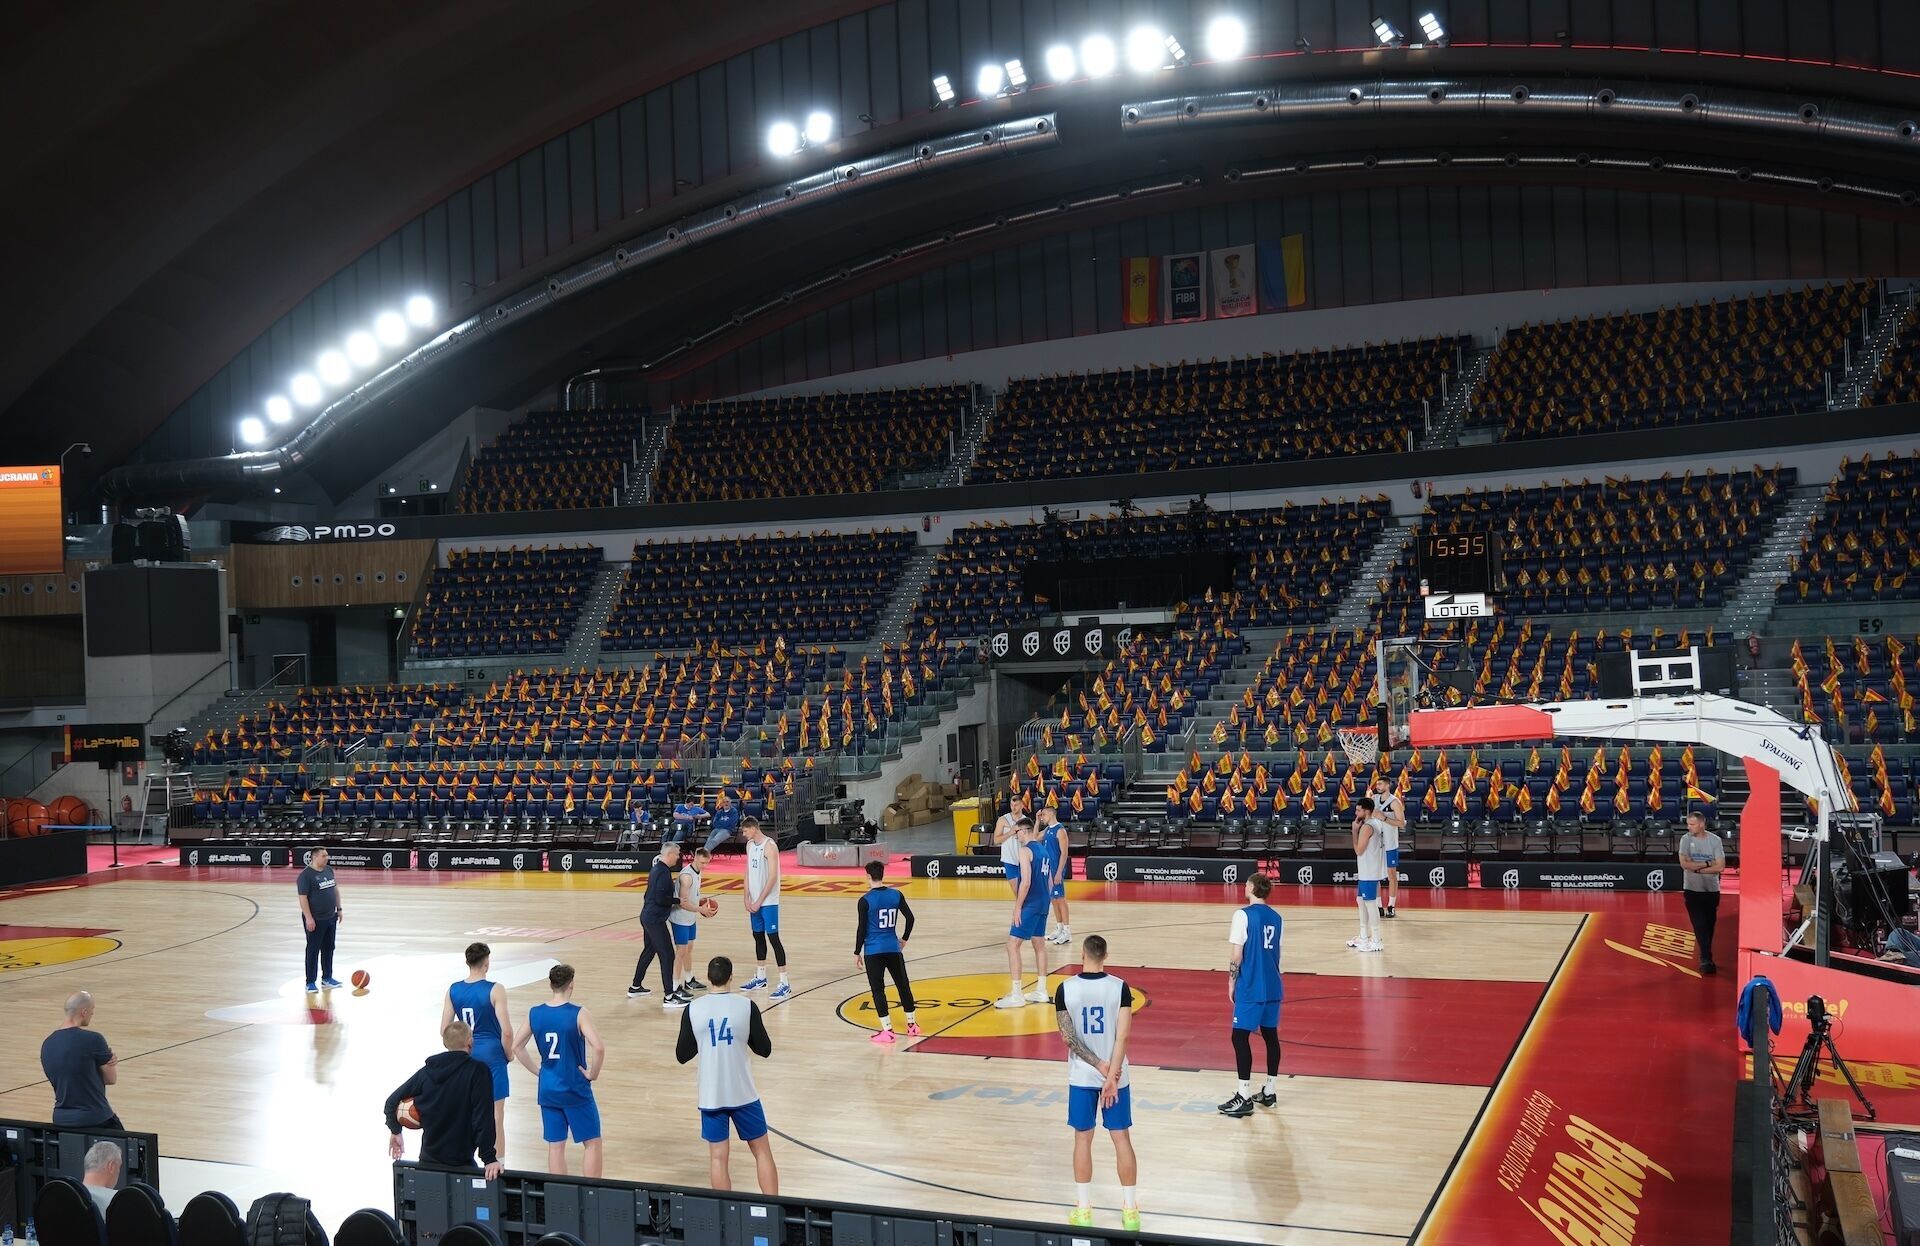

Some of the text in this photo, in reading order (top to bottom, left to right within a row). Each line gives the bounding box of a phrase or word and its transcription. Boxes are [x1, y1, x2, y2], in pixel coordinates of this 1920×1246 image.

[1175, 292, 1196, 304] FIBA
[314, 523, 396, 540] PMDO
[1428, 536, 1485, 557] 15:35
[1432, 605, 1479, 617] LOTUS
[1759, 738, 1803, 770] SPALDING
[208, 853, 252, 863] #LaFamilia
[450, 856, 501, 865] #LaFamilia
[956, 865, 1006, 875] #LaFam
[1134, 867, 1169, 875] SELECCIÓN
[1582, 873, 1624, 881] ESPAÑOLA
[878, 908, 896, 929] 50
[1263, 924, 1275, 950] 12
[1081, 1006, 1104, 1034] 13
[708, 1017, 734, 1047] 14
[545, 1032, 561, 1060] 2
